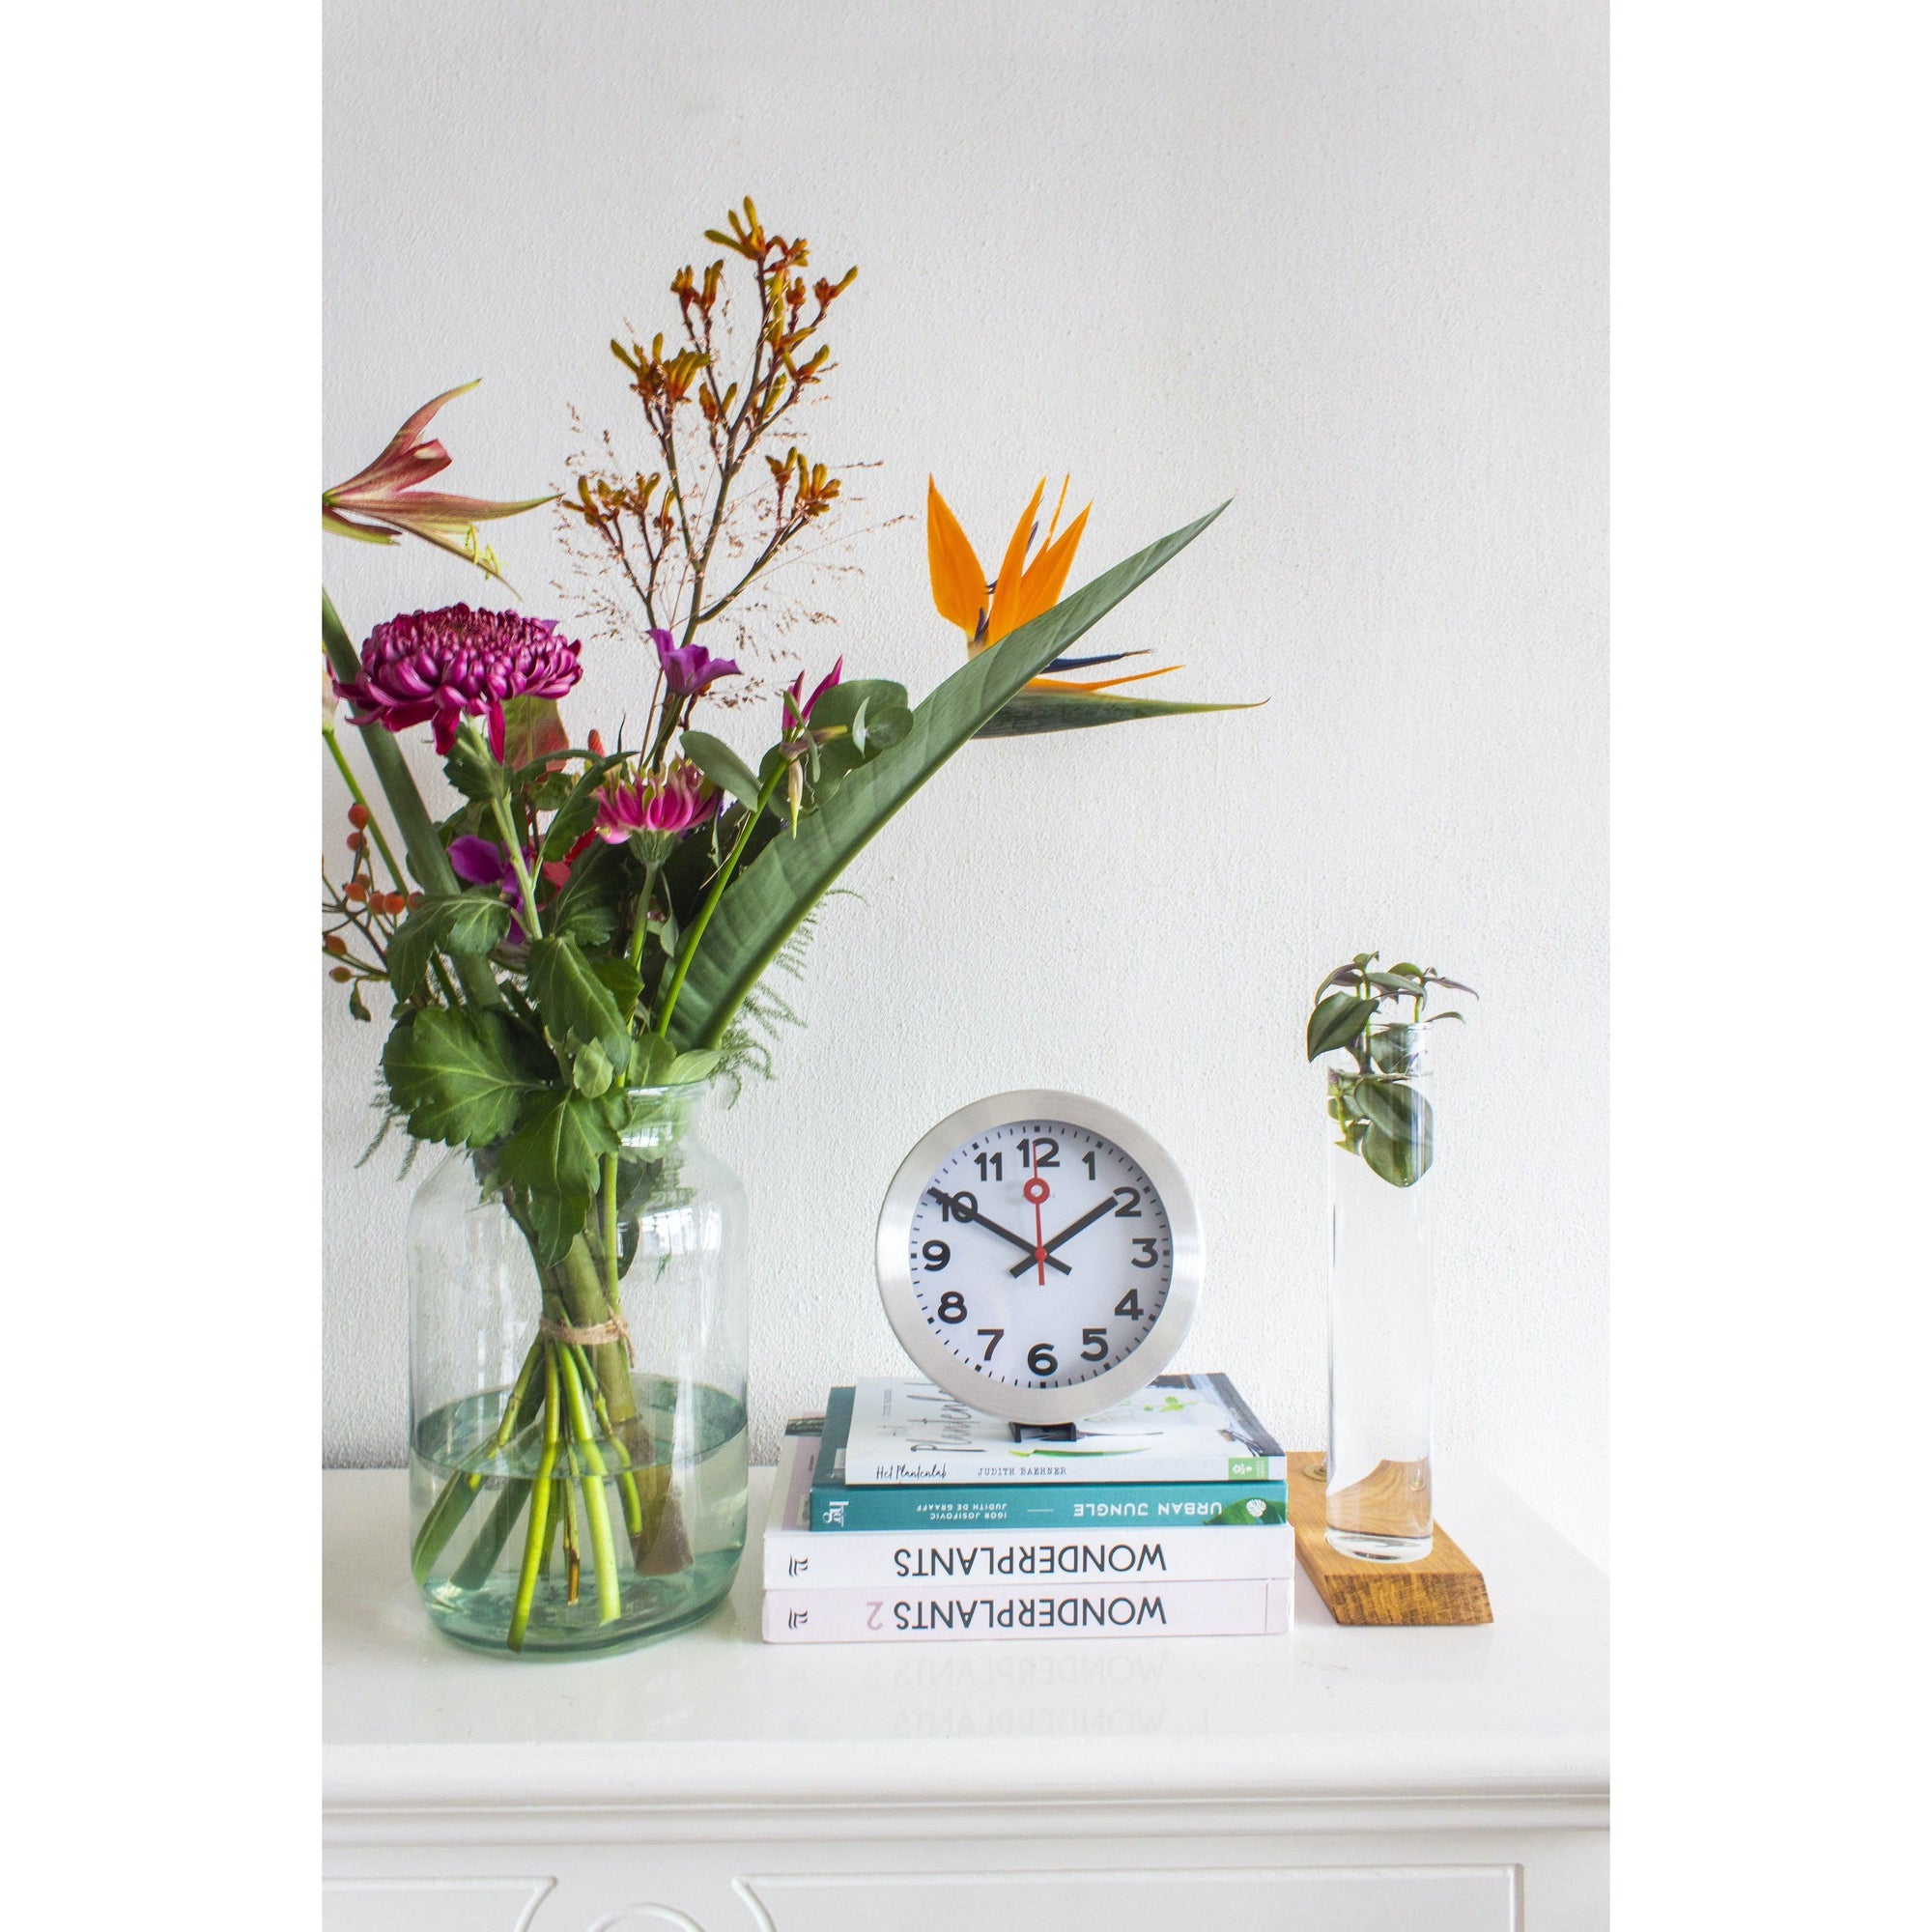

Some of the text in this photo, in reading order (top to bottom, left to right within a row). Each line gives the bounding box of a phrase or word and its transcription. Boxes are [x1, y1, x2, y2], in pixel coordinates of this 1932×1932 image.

[974, 1151, 1003, 1181] 11
[1016, 1137, 1061, 1168] 12
[1082, 1151, 1095, 1180] 1
[935, 1191, 978, 1223] 10
[1113, 1186, 1142, 1217] 2
[922, 1239, 952, 1271] 9
[1131, 1237, 1158, 1268] 3
[938, 1291, 968, 1323] 8
[1114, 1289, 1144, 1321] 4
[977, 1328, 1005, 1361] 7
[1027, 1343, 1059, 1377] 6
[1080, 1327, 1109, 1361] 5
[875, 1463, 947, 1481] Het Plantenlab
[977, 1466, 1015, 1476] JUDITH
[1073, 1501, 1223, 1517] URBAN JUNGLE
[894, 1543, 1167, 1577] WONDERPLANTS
[866, 1596, 1167, 1631] WONDERPLANTS 2
